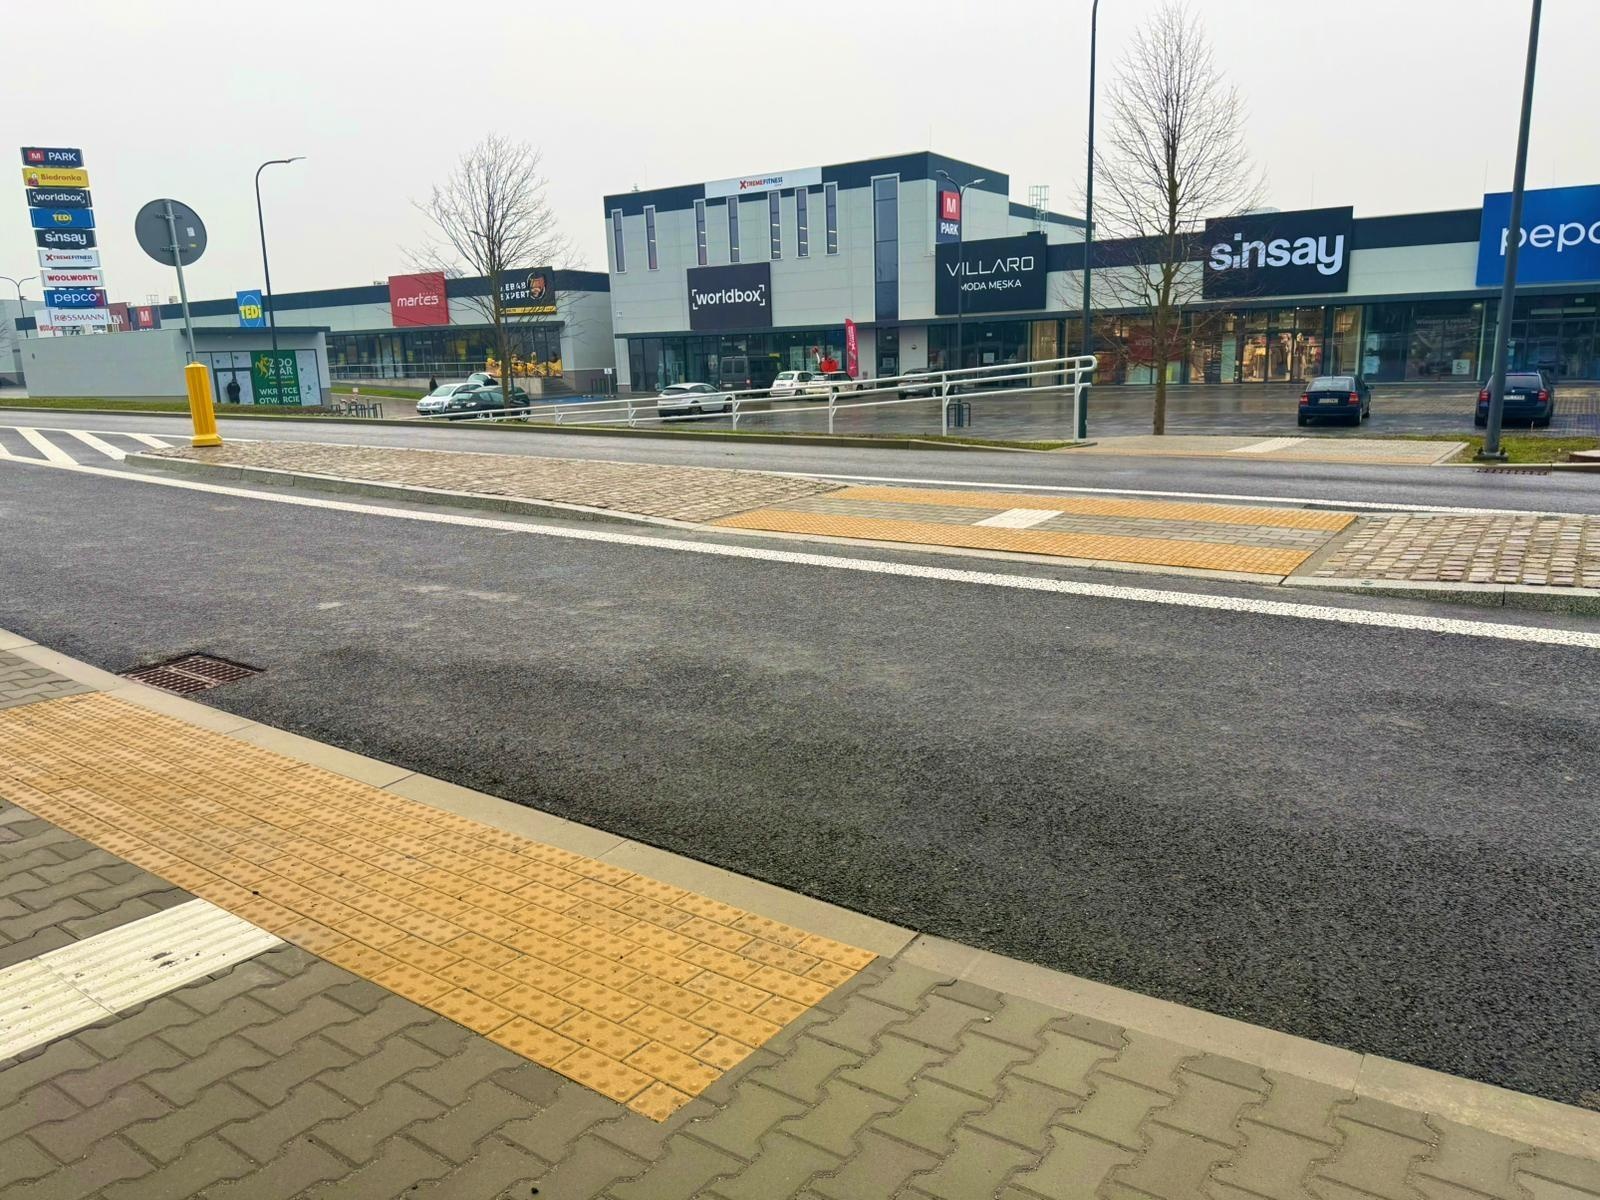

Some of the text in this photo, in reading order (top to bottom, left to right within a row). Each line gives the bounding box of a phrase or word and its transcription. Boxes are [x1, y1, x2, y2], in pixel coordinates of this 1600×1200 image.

[31, 152, 78, 162] M PARK
[41, 173, 82, 182] Biedronka
[35, 193, 83, 202] worldbox
[946, 198, 957, 213] M
[940, 222, 959, 235] PARK
[45, 231, 87, 245] sinsay
[1209, 232, 1345, 276] sinsay
[946, 256, 1035, 277] VILLARO
[961, 279, 1022, 291] MODA MĘSKA
[54, 293, 98, 304] pepco
[397, 292, 439, 307] martes
[694, 287, 762, 307] worldbox
[54, 313, 105, 322] ROSSMANN
[259, 387, 298, 396] WKRTCE
